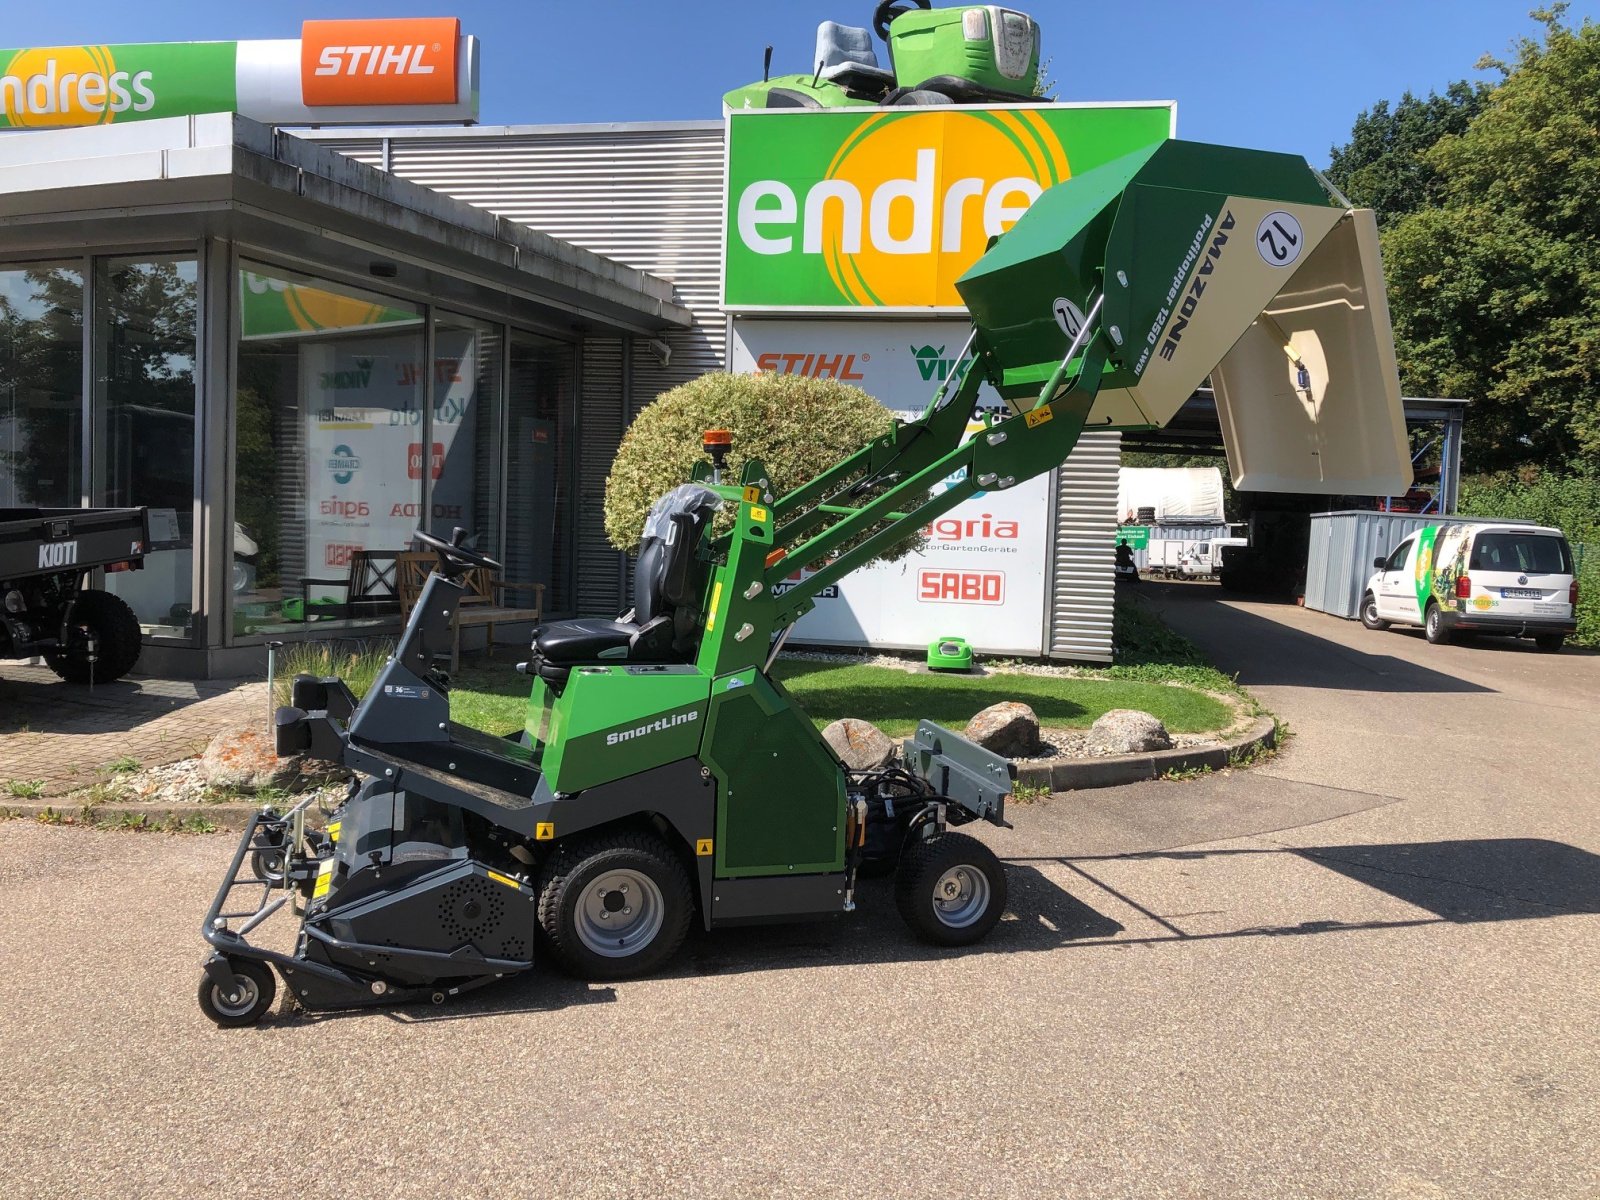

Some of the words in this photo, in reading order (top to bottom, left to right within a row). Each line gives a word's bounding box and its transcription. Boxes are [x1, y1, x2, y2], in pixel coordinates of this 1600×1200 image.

[315, 44, 435, 76] STIHL
[1259, 219, 1298, 261] 12
[1165, 213, 1213, 306] Profihopper
[1159, 209, 1236, 362] AMAZONE
[1146, 307, 1169, 345] 1250
[754, 352, 865, 380] STIHL
[38, 540, 78, 569] KIOTI
[921, 572, 1001, 602] SABO
[606, 710, 699, 746] SmartLine
